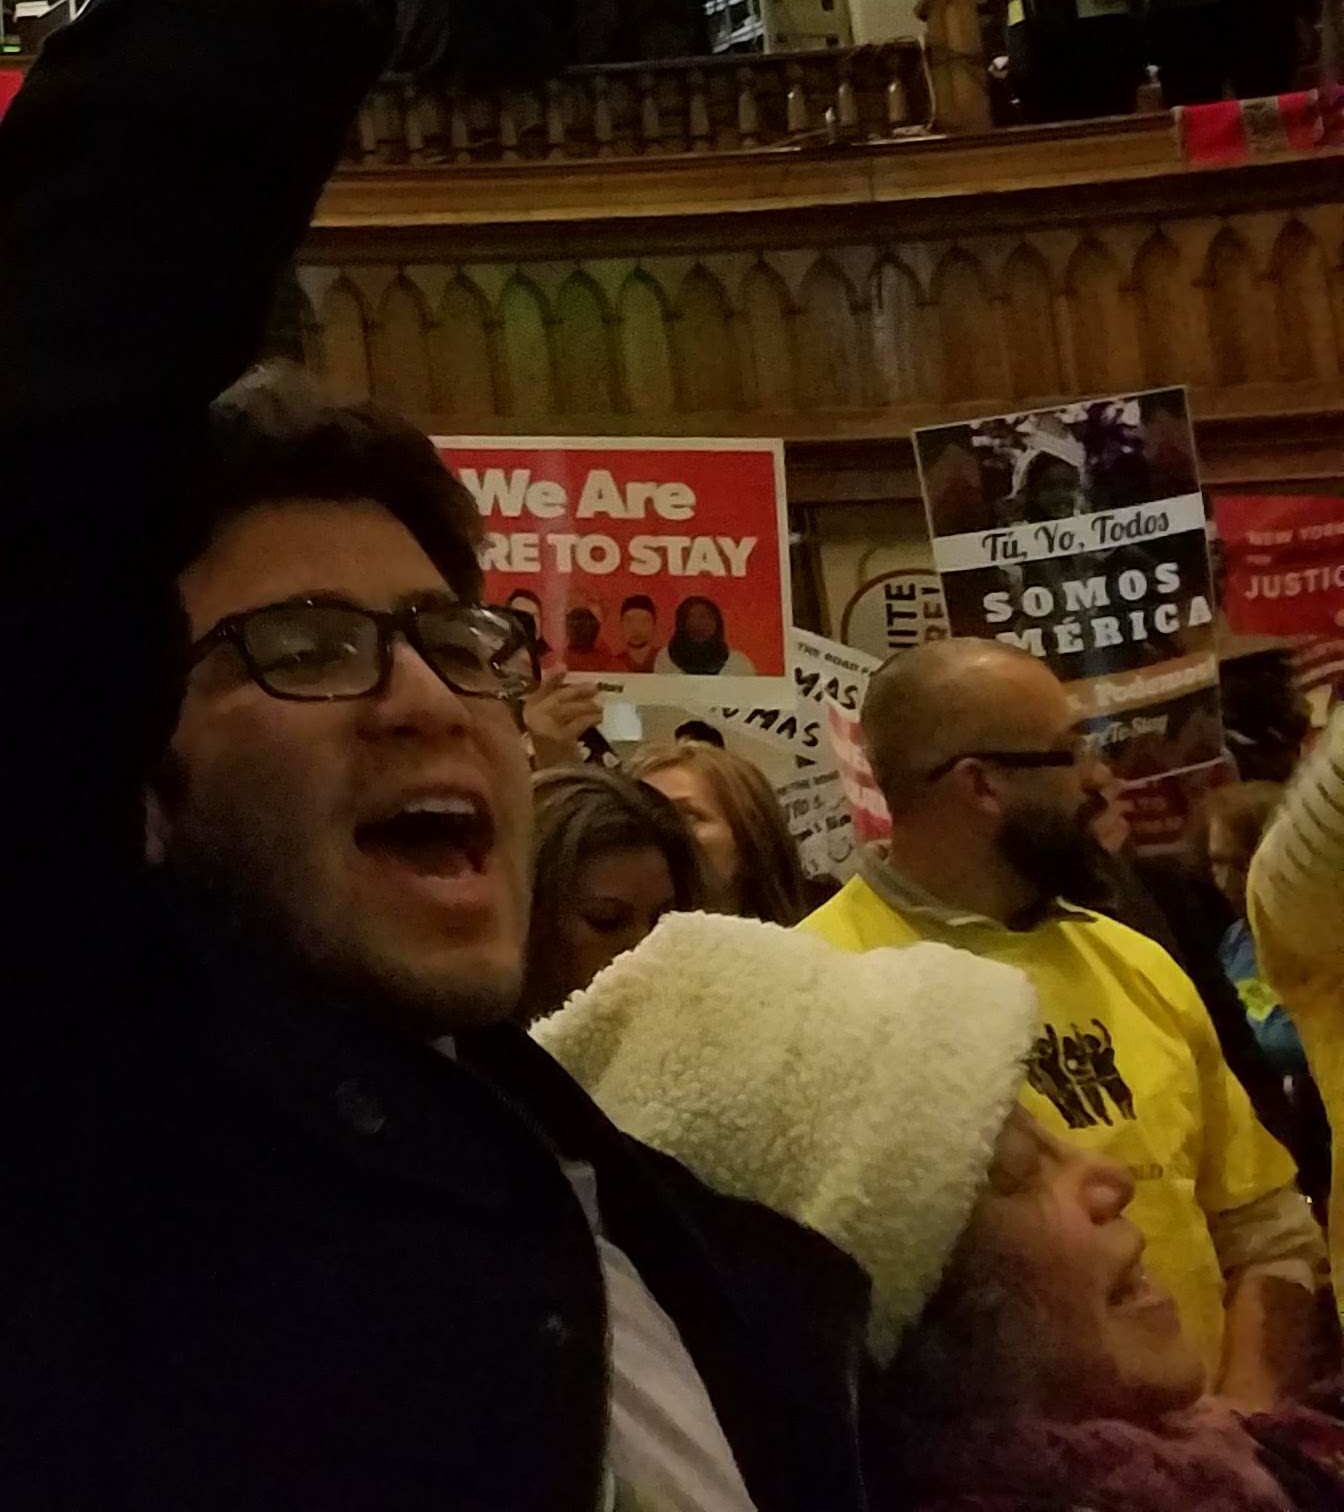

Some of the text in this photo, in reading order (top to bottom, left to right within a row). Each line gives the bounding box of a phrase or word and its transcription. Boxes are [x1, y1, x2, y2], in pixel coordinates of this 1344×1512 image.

[458, 466, 696, 522] We Are
[546, 534, 622, 576] TO
[627, 535, 759, 578] STAY
[1033, 523, 1085, 555] Yo,
[1089, 510, 1171, 545] Todos
[981, 561, 1181, 624] SOMOS
[994, 595, 1213, 659] MÉRICA
